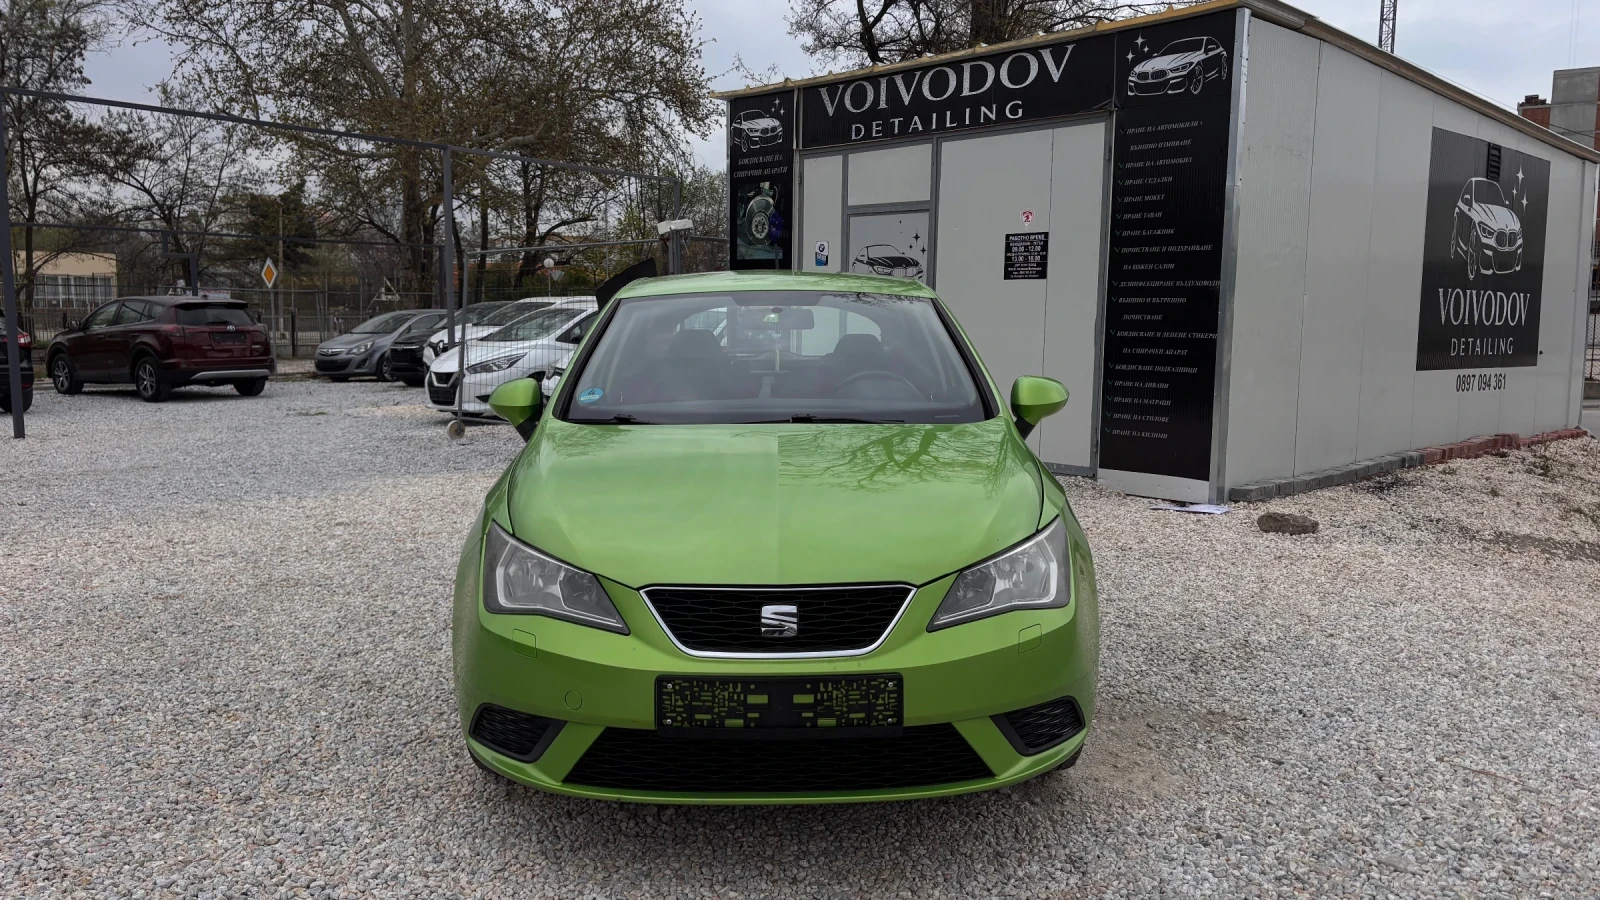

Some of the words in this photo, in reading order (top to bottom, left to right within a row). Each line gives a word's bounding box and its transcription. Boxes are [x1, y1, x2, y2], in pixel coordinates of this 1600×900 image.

[818, 44, 1077, 117] VOIVODOV
[851, 100, 1023, 140] DETAILING
[1125, 161, 1145, 169] ПРАНЕ
[1144, 176, 1173, 185] СЕДАЛКИ
[1143, 211, 1163, 219] ТАВАН
[1142, 228, 1175, 236] БАГАЖНИК
[1438, 288, 1531, 326] VOIVODOV
[1450, 337, 1514, 356] DETAILING
[1456, 374, 1476, 393] 0897
[1477, 373, 1492, 392] 094
[1493, 372, 1507, 391] 361
[1143, 398, 1172, 406] МАТРАЦИ
[1142, 414, 1170, 423] СТОЛОВЕ
[1112, 429, 1132, 437] ПРАНЕ
